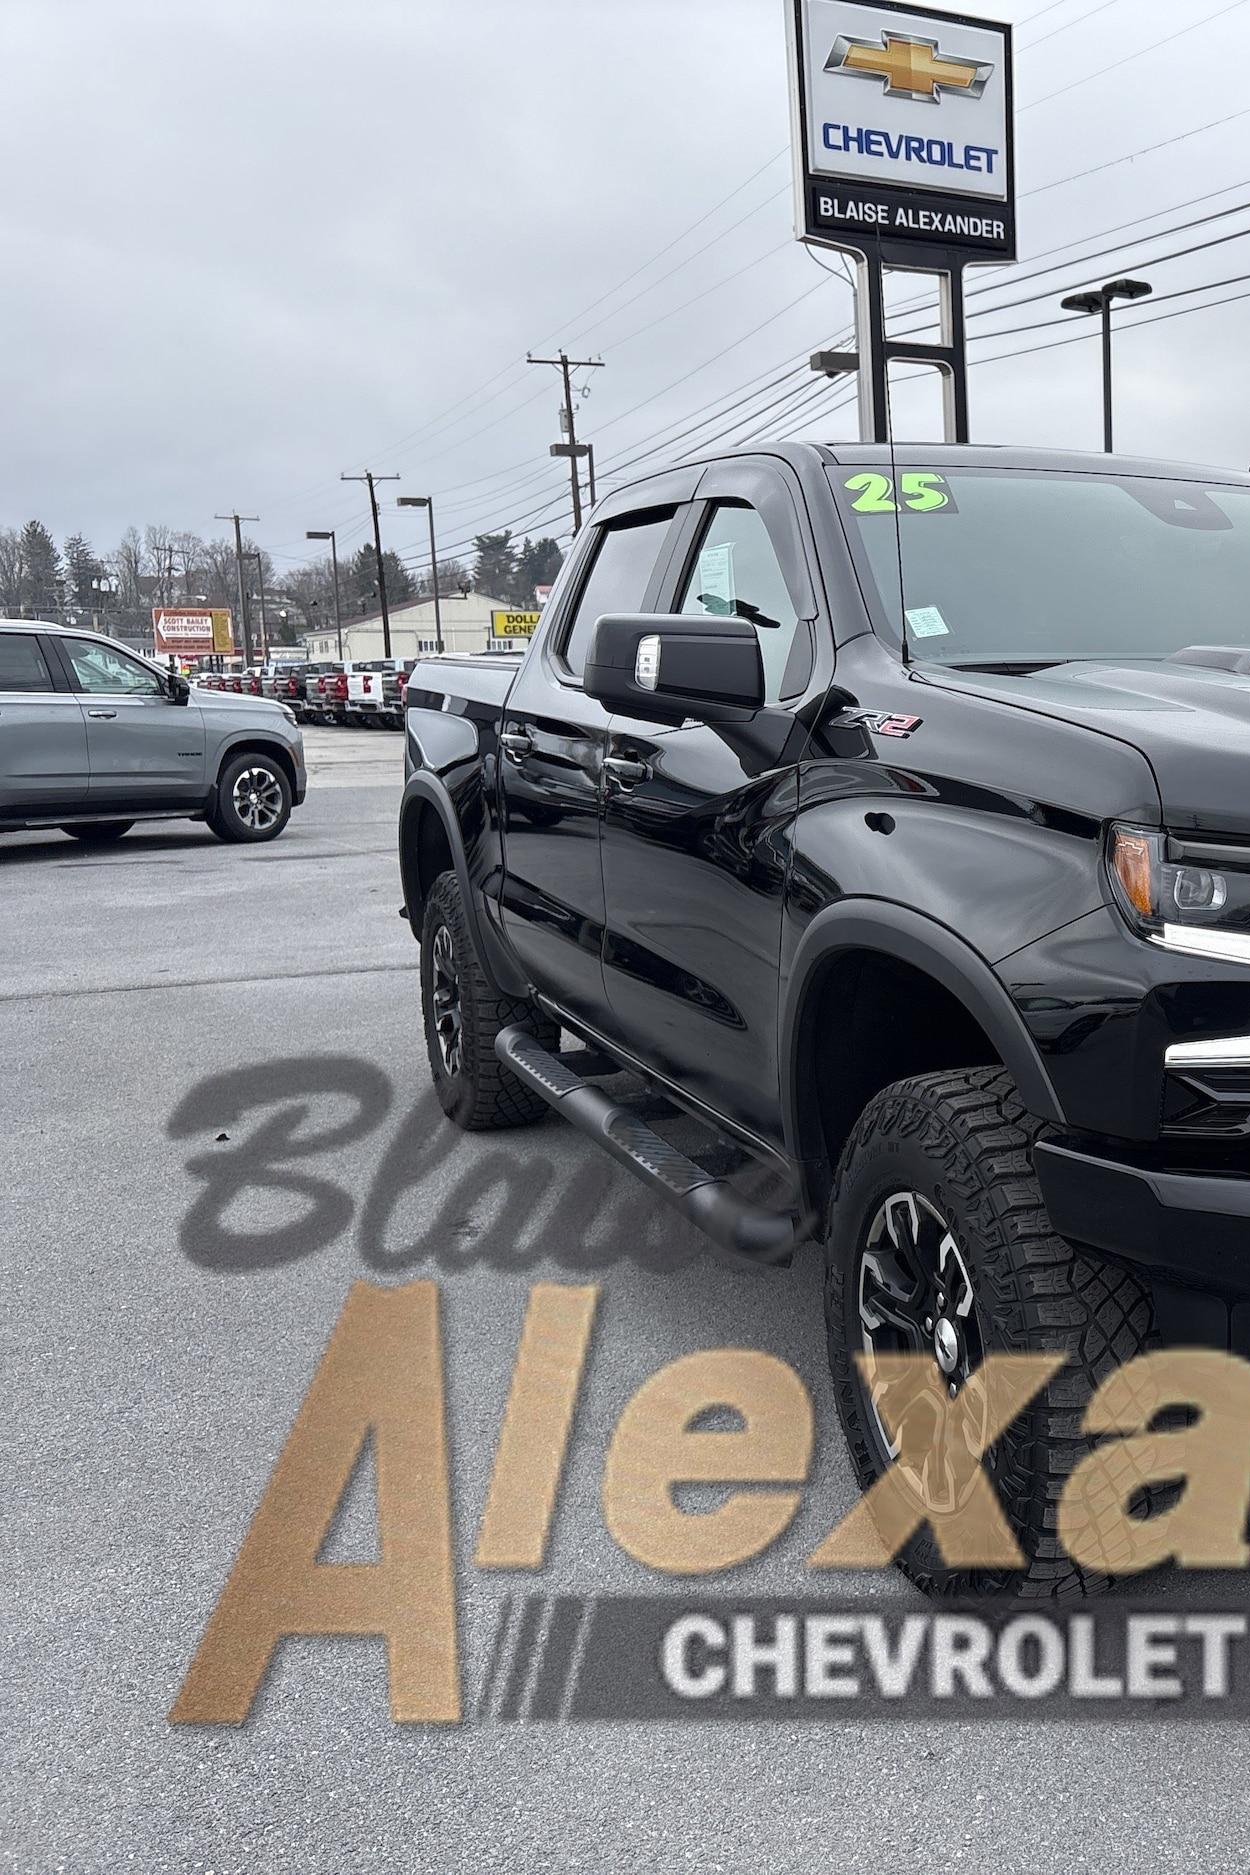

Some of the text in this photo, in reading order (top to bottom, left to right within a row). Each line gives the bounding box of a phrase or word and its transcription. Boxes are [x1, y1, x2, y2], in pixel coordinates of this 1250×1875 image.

[822, 122, 998, 174] CHEVROLET
[819, 196, 1005, 239] BLAISE ALEXANDER
[844, 472, 949, 512] 25
[162, 625, 211, 633] CONSTRUCTION
[504, 625, 537, 635] GENE
[506, 614, 541, 624] DOLL
